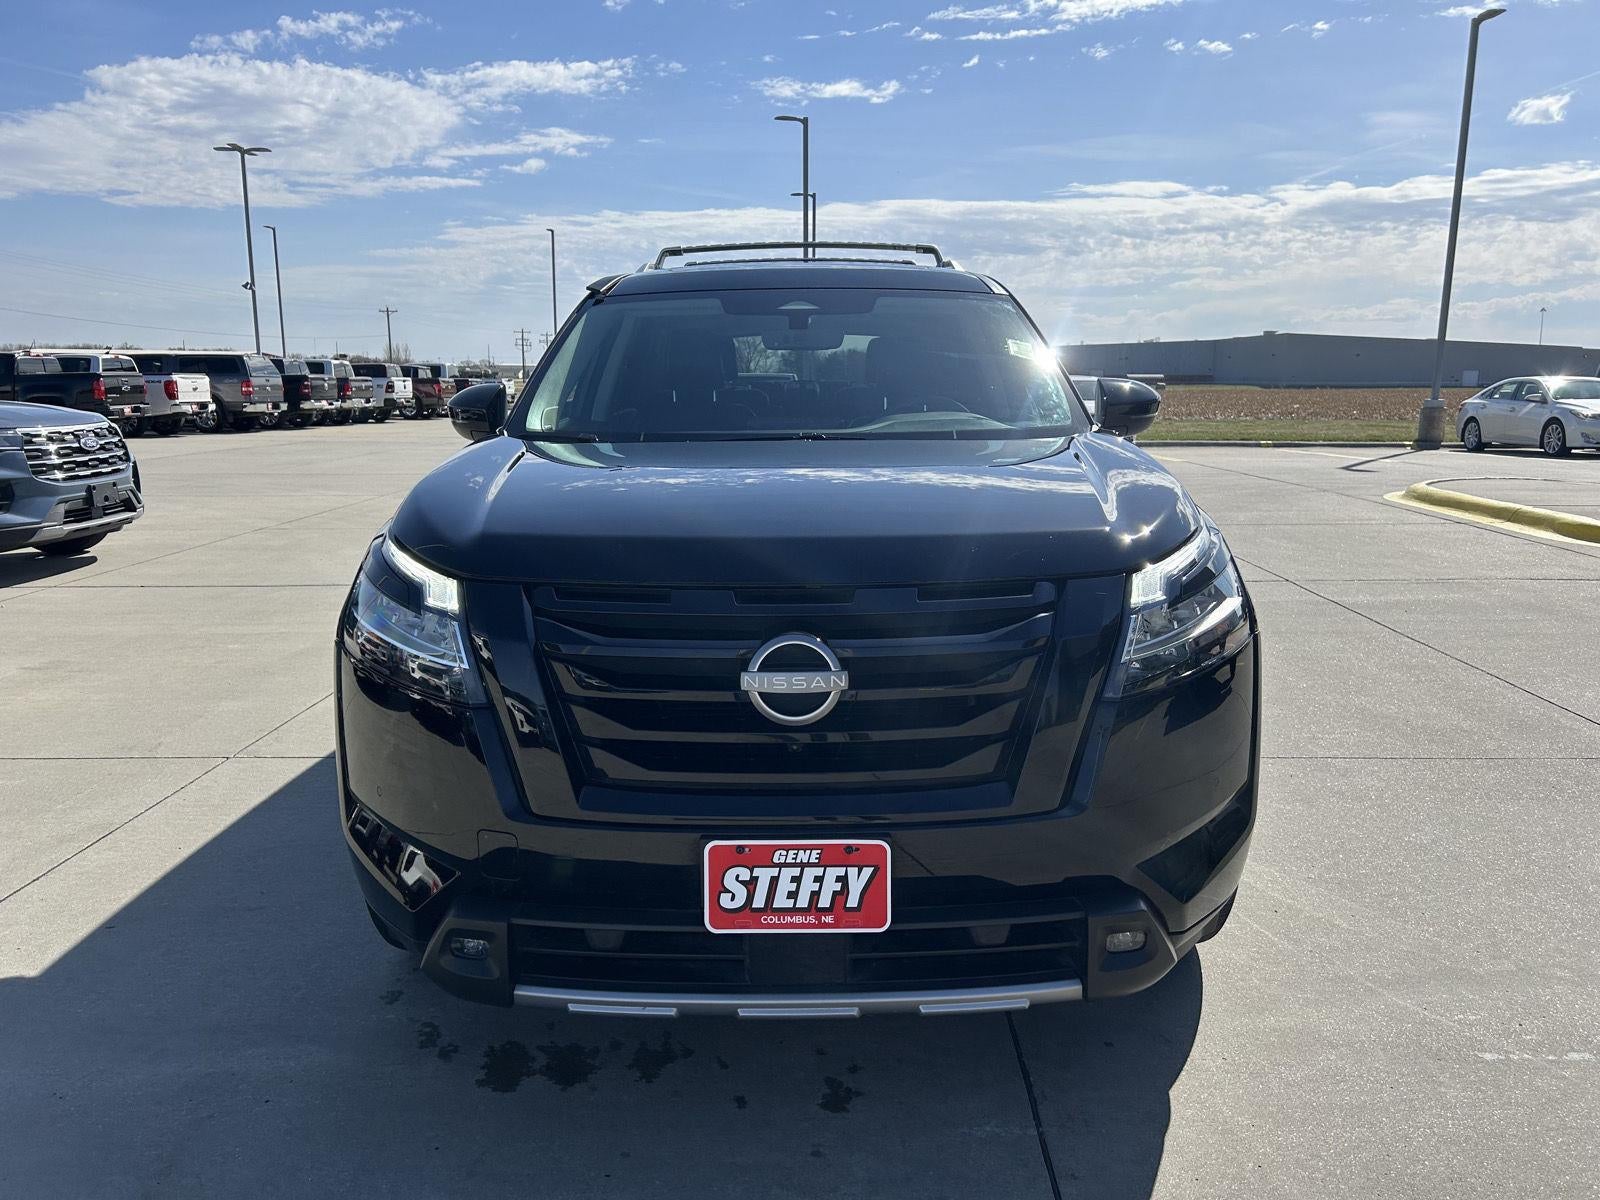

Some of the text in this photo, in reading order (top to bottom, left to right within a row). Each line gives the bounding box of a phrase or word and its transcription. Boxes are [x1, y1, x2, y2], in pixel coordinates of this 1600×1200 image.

[744, 674, 846, 689] NISSAN
[772, 849, 822, 864] GENE
[719, 866, 877, 911] STEFFY
[761, 915, 835, 925] COLUMBUS, NE
